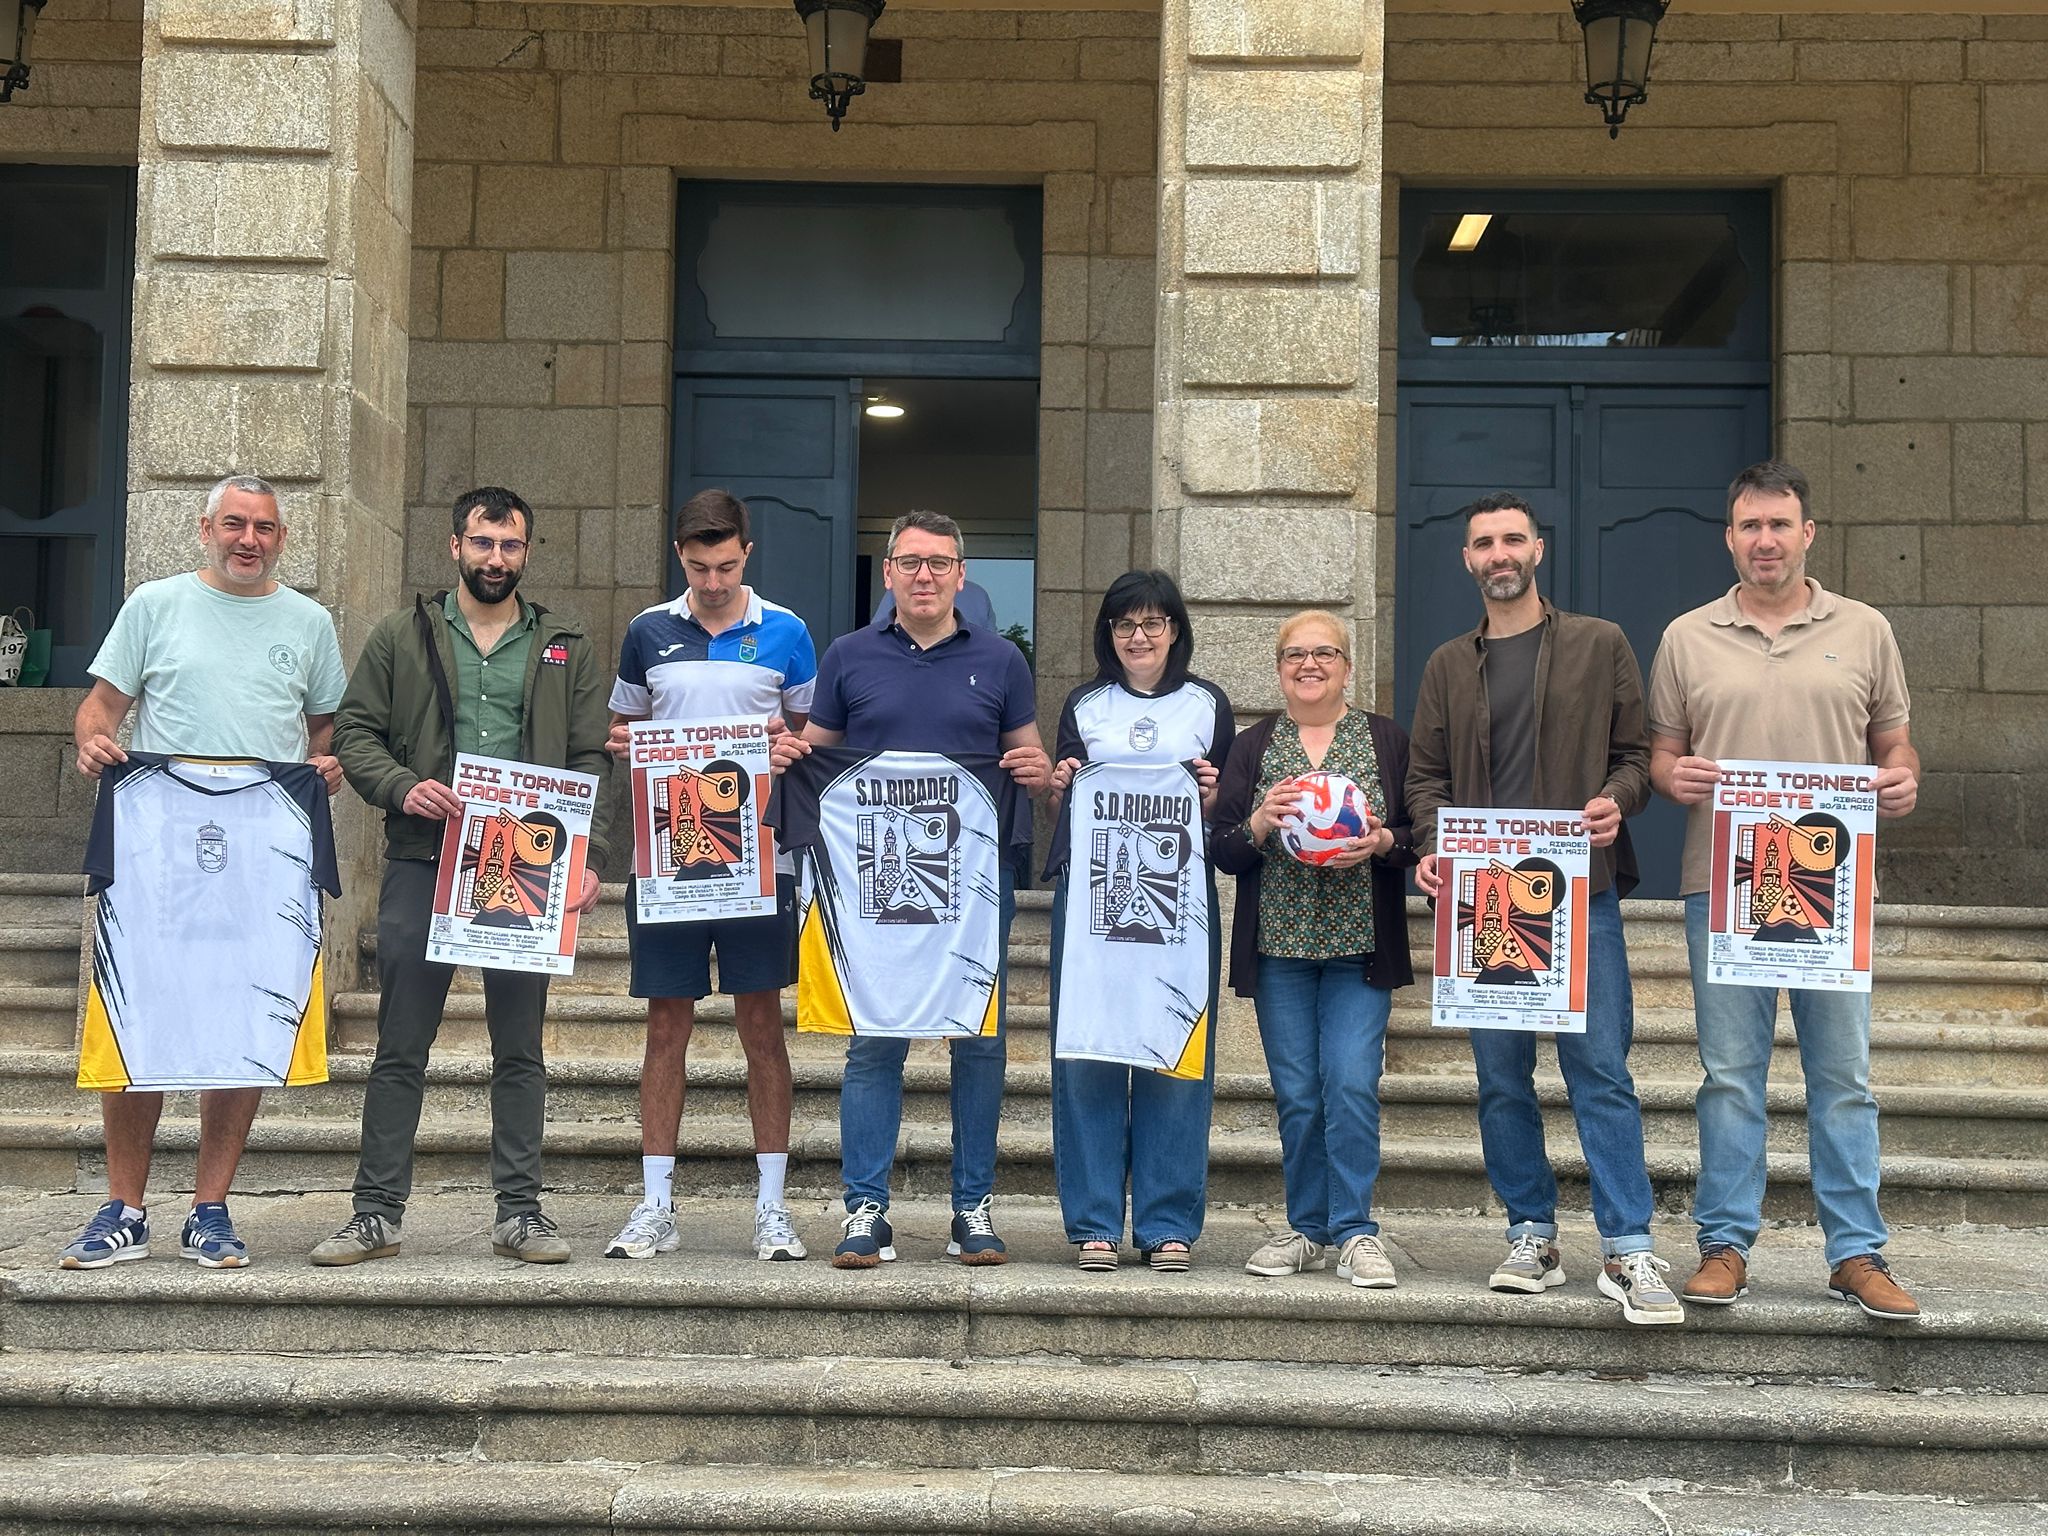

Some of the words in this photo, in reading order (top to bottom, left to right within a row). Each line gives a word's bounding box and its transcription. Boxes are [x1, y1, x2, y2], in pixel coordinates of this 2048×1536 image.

[634, 728, 674, 745] III
[683, 724, 762, 742] TORNEO
[635, 744, 716, 763] CADETE
[459, 763, 501, 783] III
[510, 771, 592, 799] TORNEO
[1720, 770, 1767, 788] III
[1777, 772, 1871, 792] TORNEO
[457, 781, 540, 808] CADETE
[556, 799, 592, 809] RIBADEO
[1720, 790, 1814, 809] CADETE
[570, 807, 590, 816] MAIO
[1443, 818, 1487, 834] III
[1496, 819, 1585, 836] TORNEO
[1442, 837, 1532, 855] CADETE
